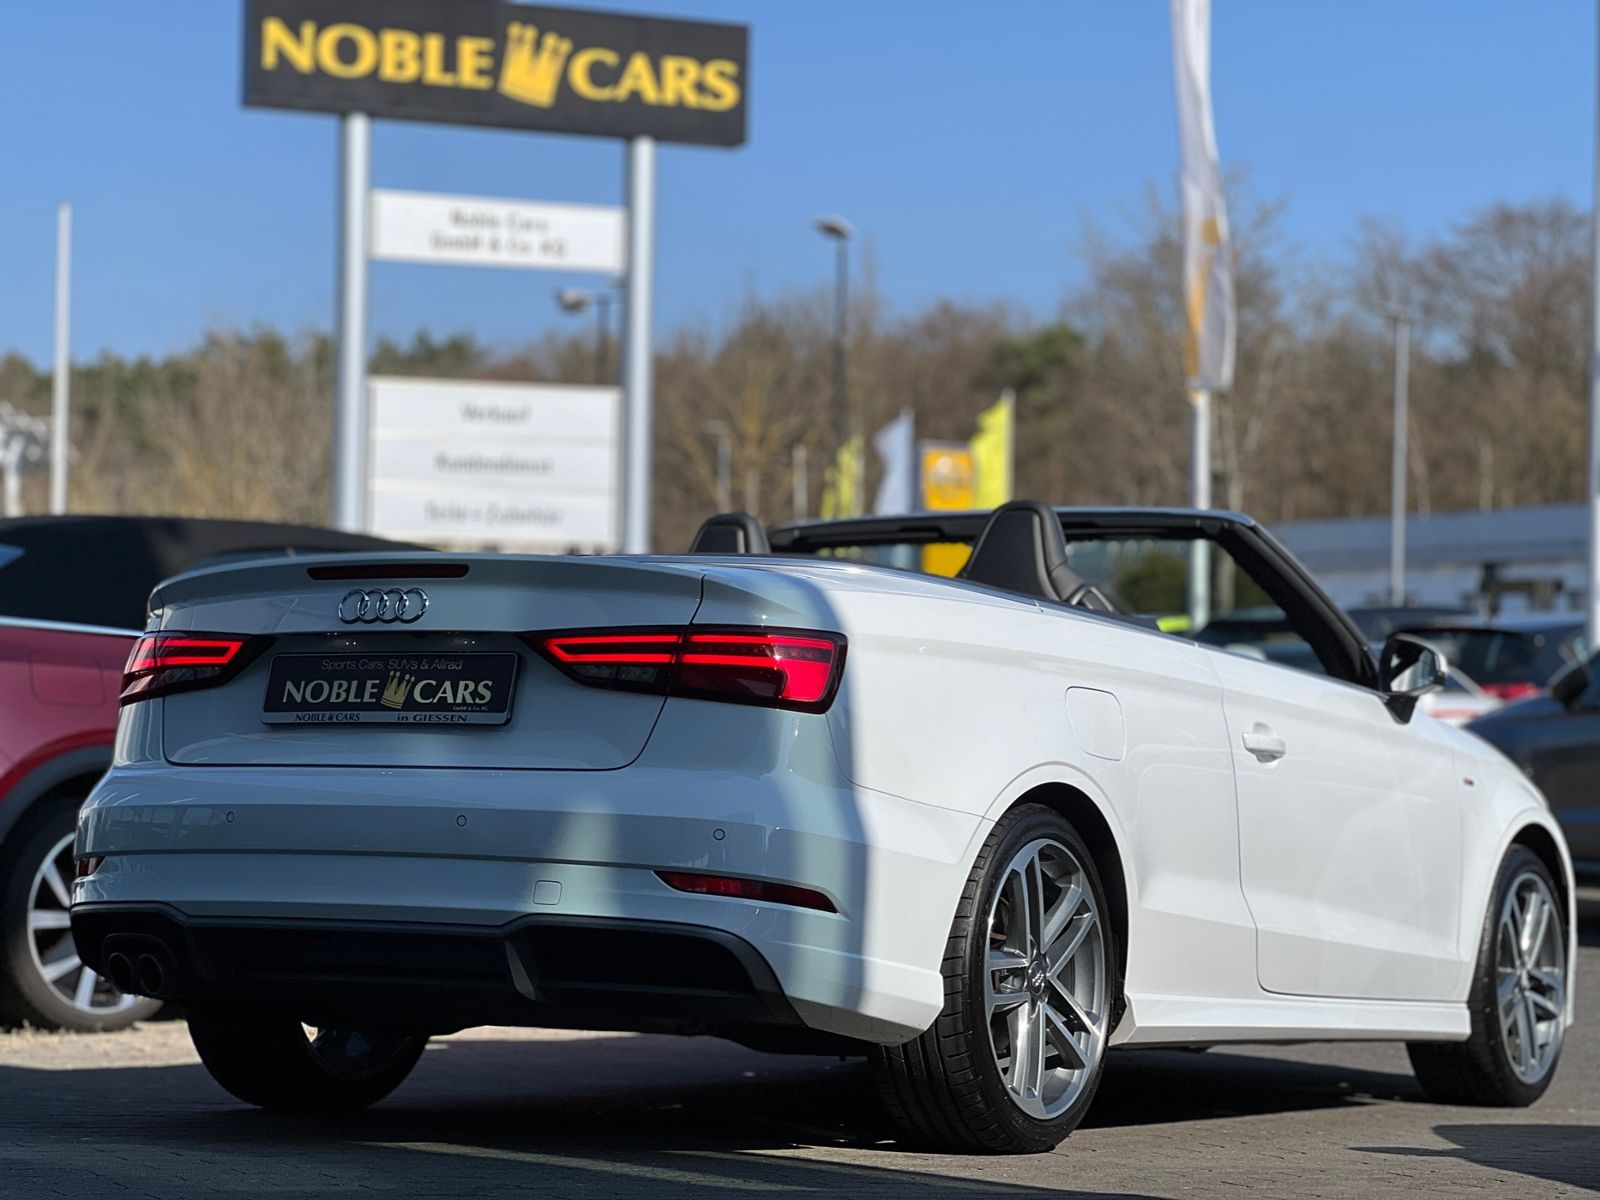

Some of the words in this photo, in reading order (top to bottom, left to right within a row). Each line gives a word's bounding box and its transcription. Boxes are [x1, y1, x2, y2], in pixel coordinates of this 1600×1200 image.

[261, 15, 495, 91] NOBLE
[567, 46, 742, 112] CARS
[321, 658, 356, 671] Sports
[387, 658, 418, 670] SUVs
[420, 659, 429, 670] &
[430, 658, 464, 670] Allrad
[281, 679, 381, 703] NOBLE
[412, 679, 493, 705] CARS
[294, 713, 328, 722] NOBLE
[336, 712, 361, 722] CARS
[396, 713, 409, 722] in
[412, 713, 468, 723] GIESSEN
